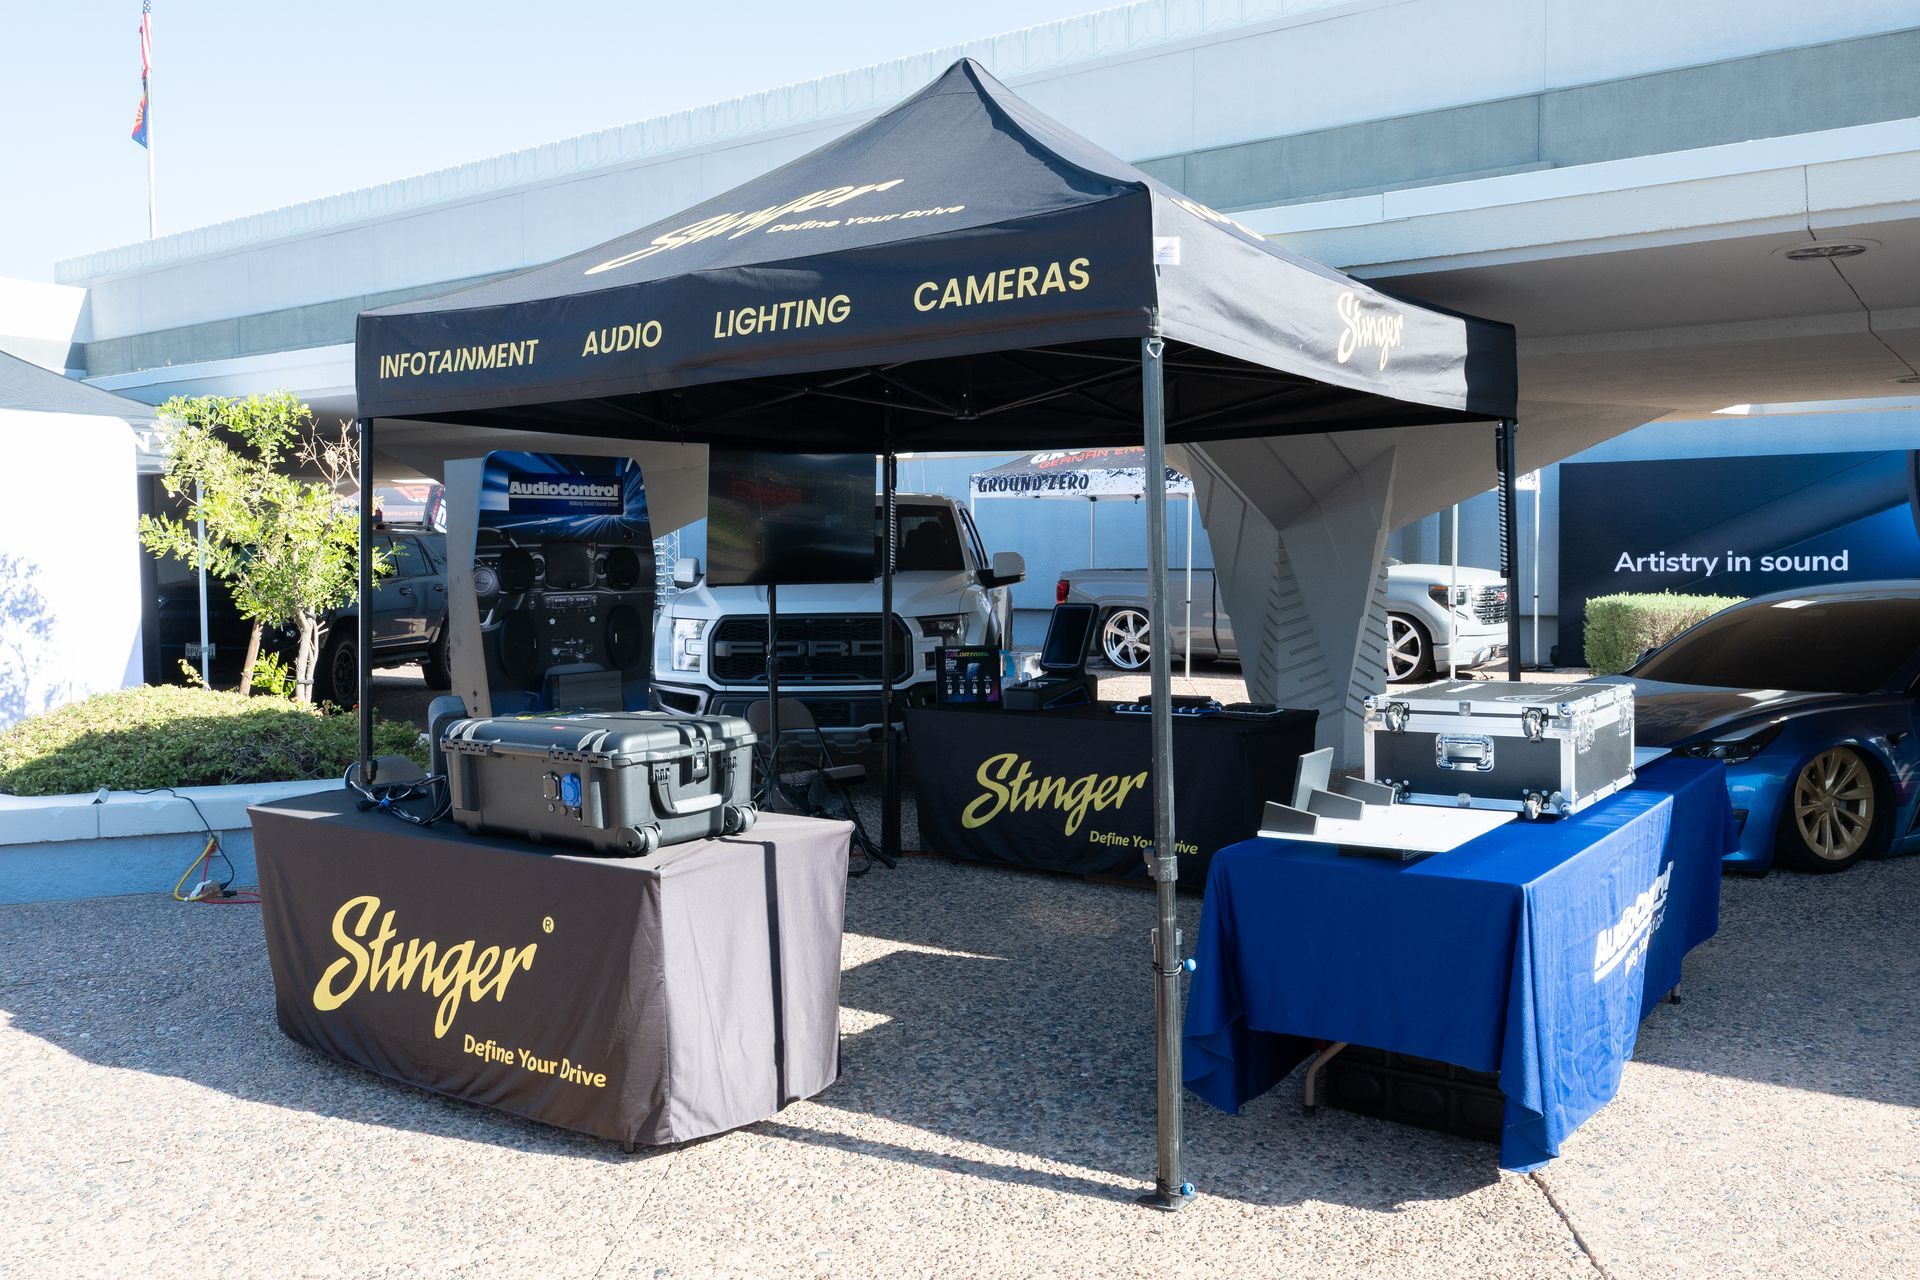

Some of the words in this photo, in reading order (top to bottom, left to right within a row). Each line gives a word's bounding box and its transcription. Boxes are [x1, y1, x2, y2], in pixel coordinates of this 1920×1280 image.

[584, 179, 904, 275] Stinger
[766, 219, 841, 234] Define
[845, 212, 900, 226] Your
[900, 205, 966, 219] Drive
[379, 339, 539, 379] INFOTAINMENT
[582, 320, 663, 357] AUDIO
[714, 294, 851, 339] LIGHTING
[913, 257, 1090, 312] CAMERAS
[1337, 291, 1403, 371] Stinger
[1039, 449, 1109, 469] GERMAN
[509, 481, 619, 497] AudioControl
[978, 474, 1042, 493] GROUND
[1048, 474, 1090, 491] ZERO
[1614, 551, 1719, 577] Artistry
[1727, 550, 1751, 572] in
[1760, 549, 1849, 572] sound
[961, 753, 1148, 836] Stinger
[1089, 830, 1129, 847] Define
[1175, 840, 1199, 855] rive
[313, 895, 537, 1038] Stinger
[463, 1033, 514, 1063] Define
[518, 1048, 558, 1075] Your
[560, 1057, 607, 1088] Drive
